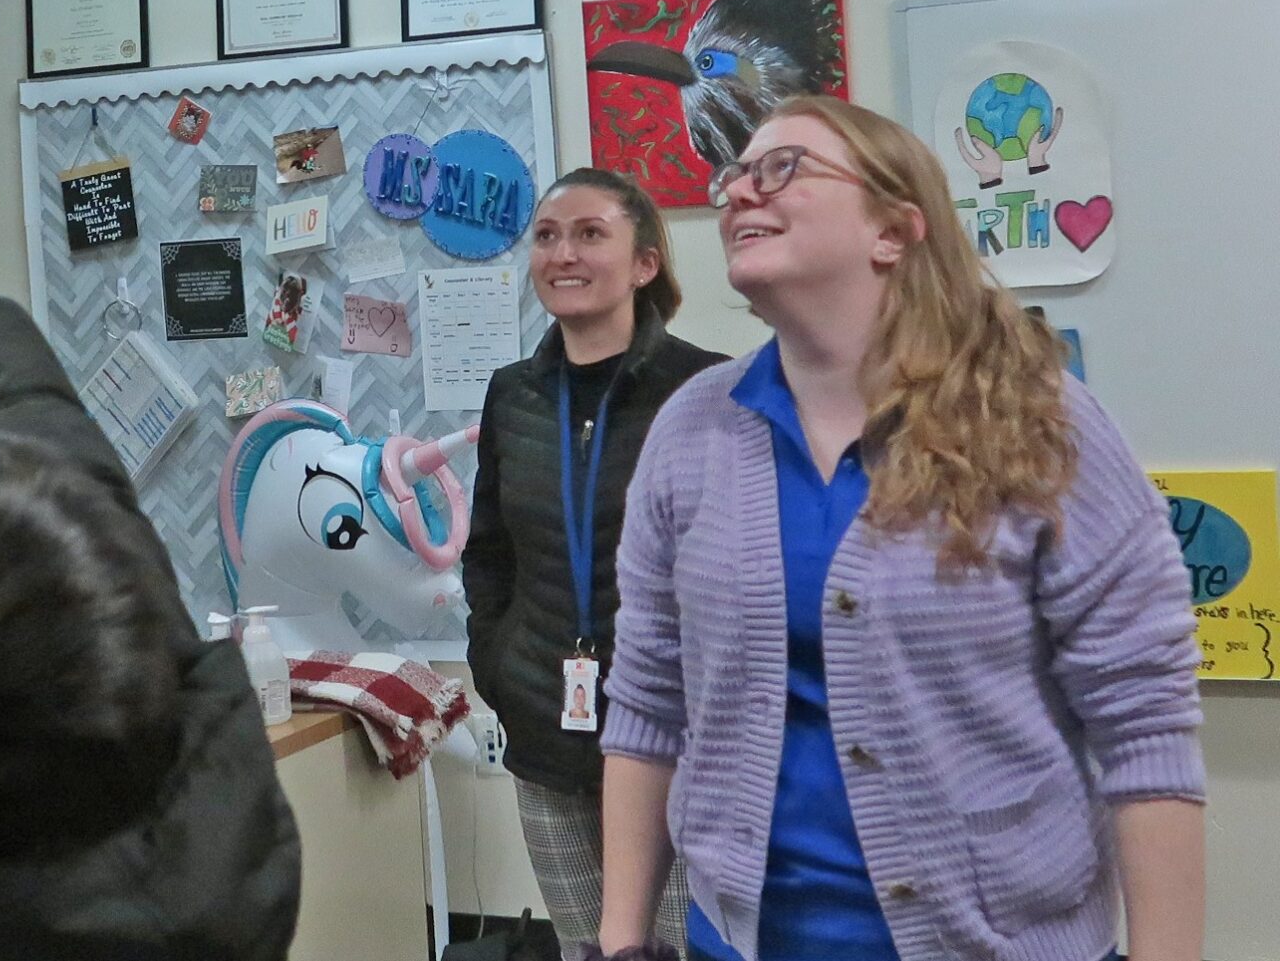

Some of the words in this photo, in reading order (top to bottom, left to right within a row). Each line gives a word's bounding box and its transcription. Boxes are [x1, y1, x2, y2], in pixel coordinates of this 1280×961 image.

[100, 172, 122, 182] Great
[376, 146, 431, 206] MS
[434, 164, 519, 235] SARA
[73, 201, 91, 212] Hard
[104, 194, 121, 205] Find
[67, 209, 99, 222] Difficult
[112, 201, 131, 211] Part
[85, 217, 102, 225] With
[103, 212, 118, 222] And
[86, 221, 121, 235] Impossible
[98, 230, 122, 241] Forget
[1187, 564, 1228, 598] re
